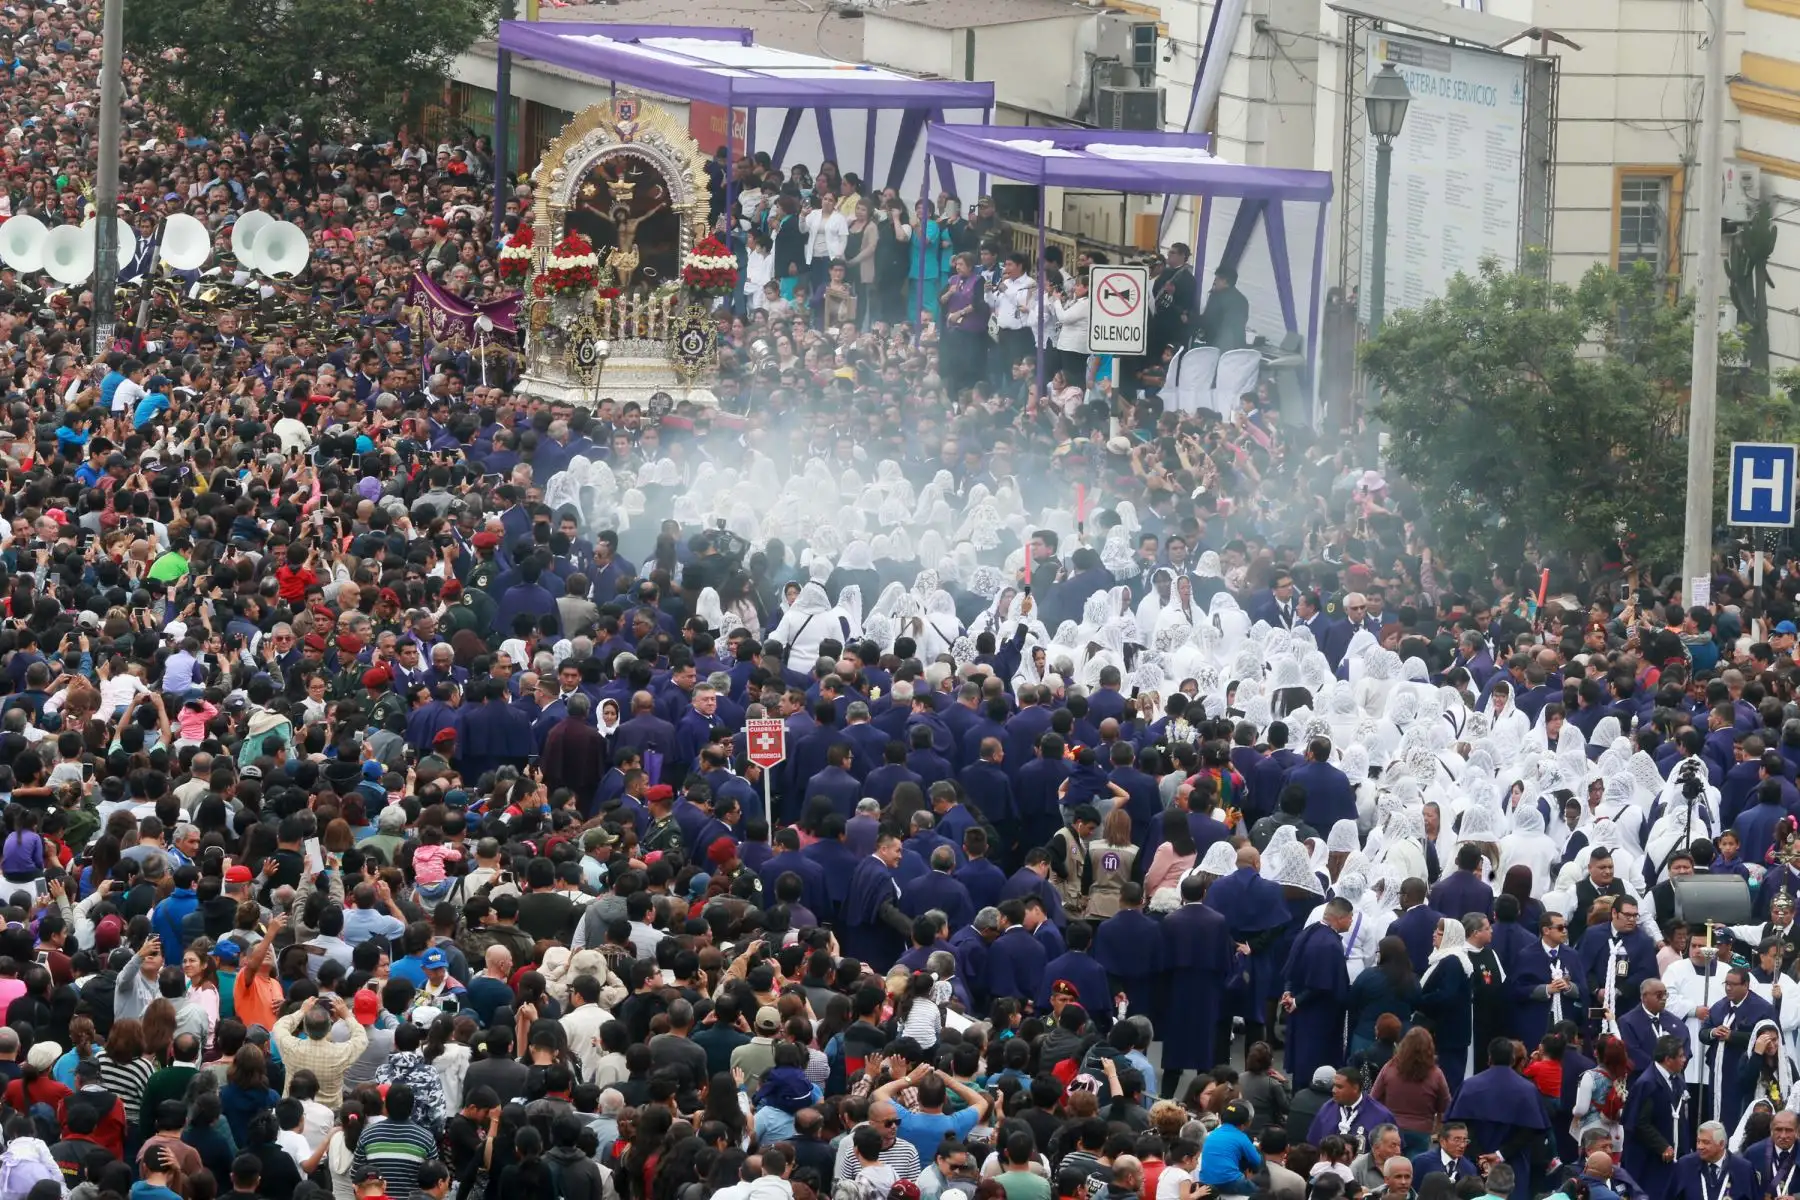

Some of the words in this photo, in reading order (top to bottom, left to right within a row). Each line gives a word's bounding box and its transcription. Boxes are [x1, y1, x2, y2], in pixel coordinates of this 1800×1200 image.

[1439, 78, 1451, 98] DE
[1452, 80, 1497, 108] SERVICIOS
[1093, 325, 1141, 342] SILENCIO
[1740, 457, 1785, 512] H
